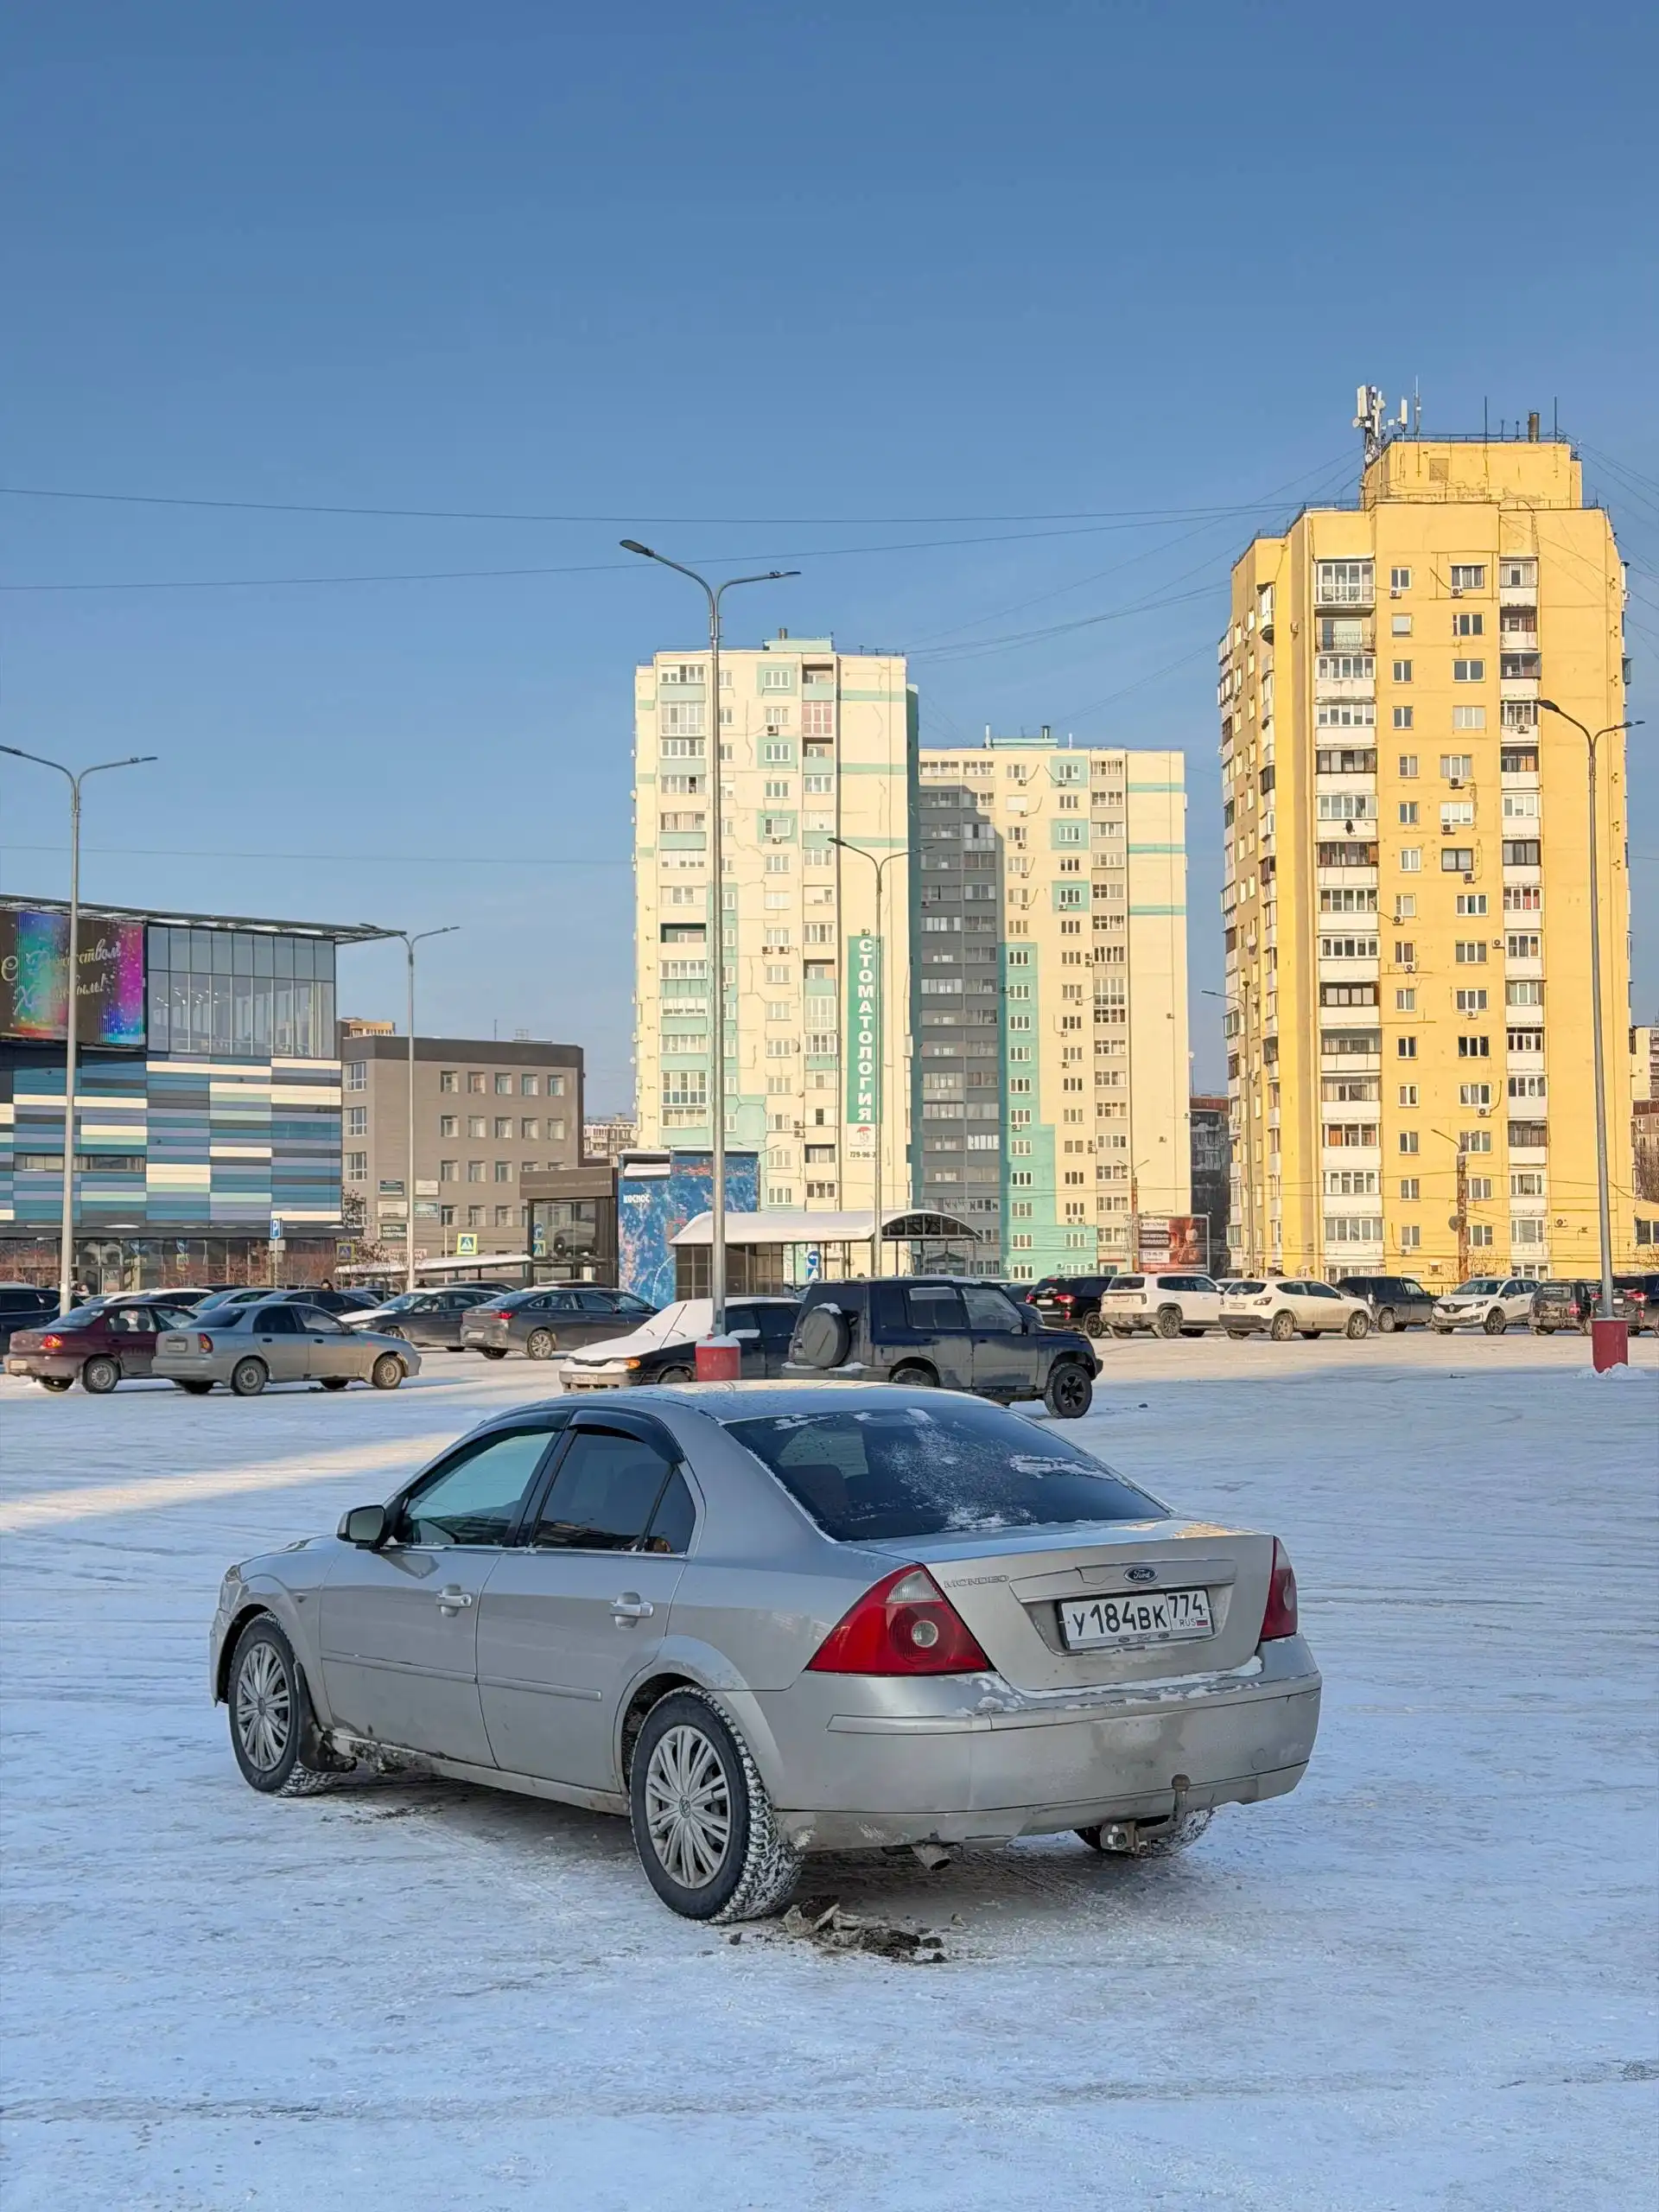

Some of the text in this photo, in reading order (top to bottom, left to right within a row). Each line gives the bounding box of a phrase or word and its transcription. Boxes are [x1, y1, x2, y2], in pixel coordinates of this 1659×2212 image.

[857, 938, 874, 1121] СТОМАТОЛОГИЯ
[943, 1574, 1009, 1589] MONDEO
[1072, 1593, 1203, 1636] У184ВК 774
[1179, 1618, 1196, 1626] RUS
